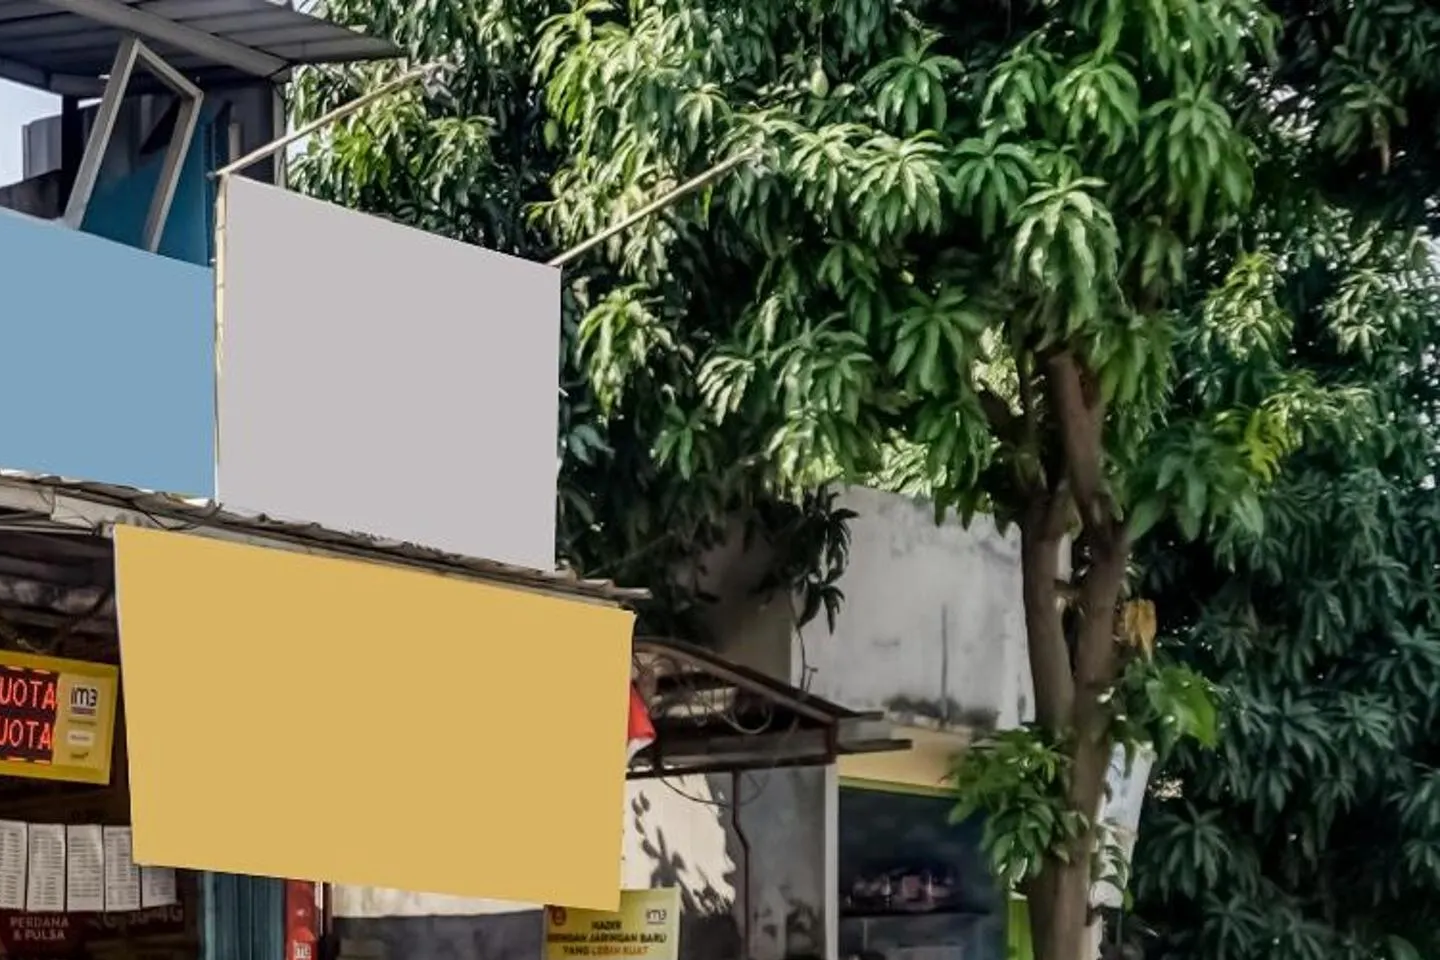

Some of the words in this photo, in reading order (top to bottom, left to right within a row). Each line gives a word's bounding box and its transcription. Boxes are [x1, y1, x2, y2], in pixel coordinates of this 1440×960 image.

[10, 916, 69, 928] PERDANA
[24, 930, 66, 941] PULSA
[640, 932, 667, 944] BARU
